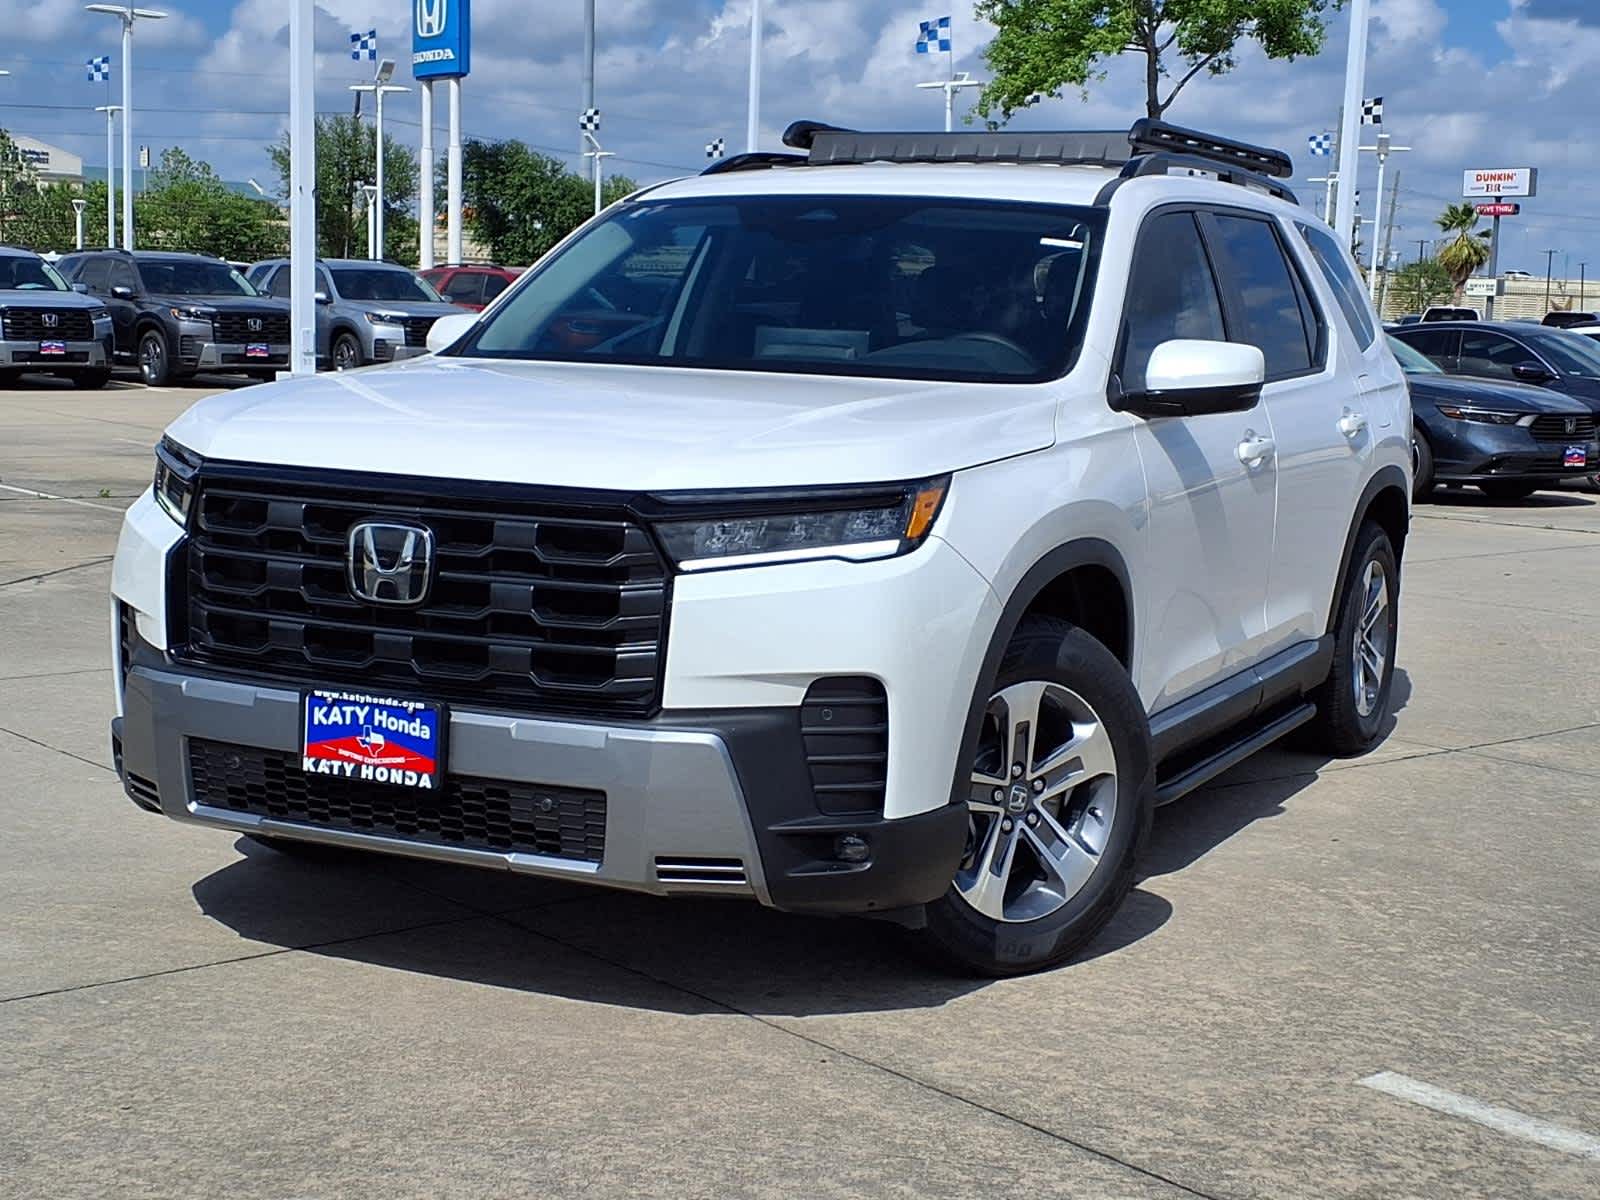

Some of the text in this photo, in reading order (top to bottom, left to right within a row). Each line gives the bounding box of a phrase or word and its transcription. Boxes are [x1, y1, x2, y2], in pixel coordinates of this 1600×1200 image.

[413, 48, 455, 64] HONDA
[314, 690, 425, 709] www.katyhonda.com
[313, 706, 431, 740] KATY Honda
[302, 757, 432, 789] KATY HONDA
